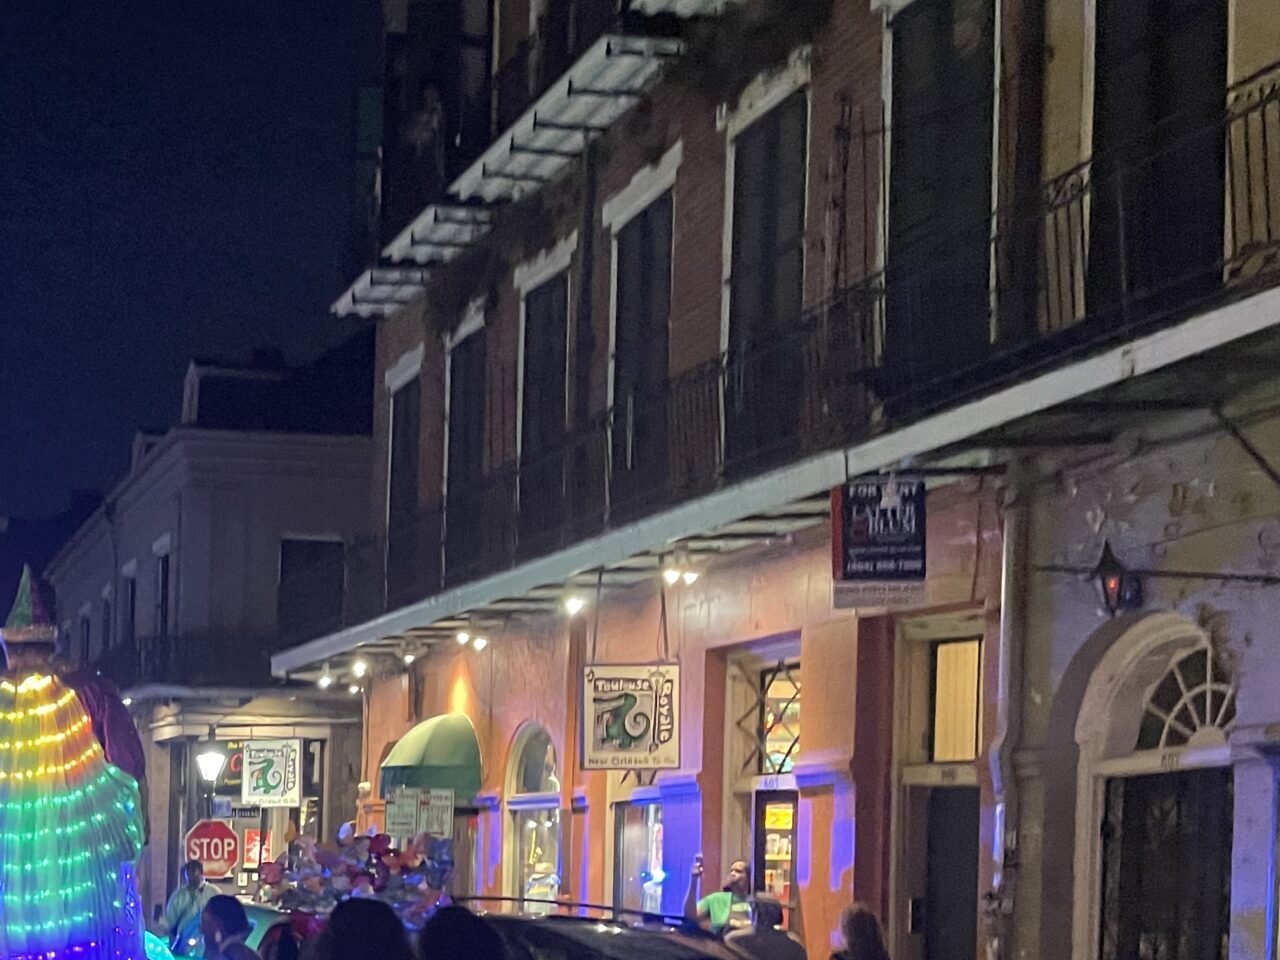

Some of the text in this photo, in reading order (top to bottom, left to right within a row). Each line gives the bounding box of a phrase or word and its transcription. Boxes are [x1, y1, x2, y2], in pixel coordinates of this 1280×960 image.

[595, 679, 650, 692] Toulouse
[658, 681, 672, 742] Royale
[189, 838, 235, 861] STOP
